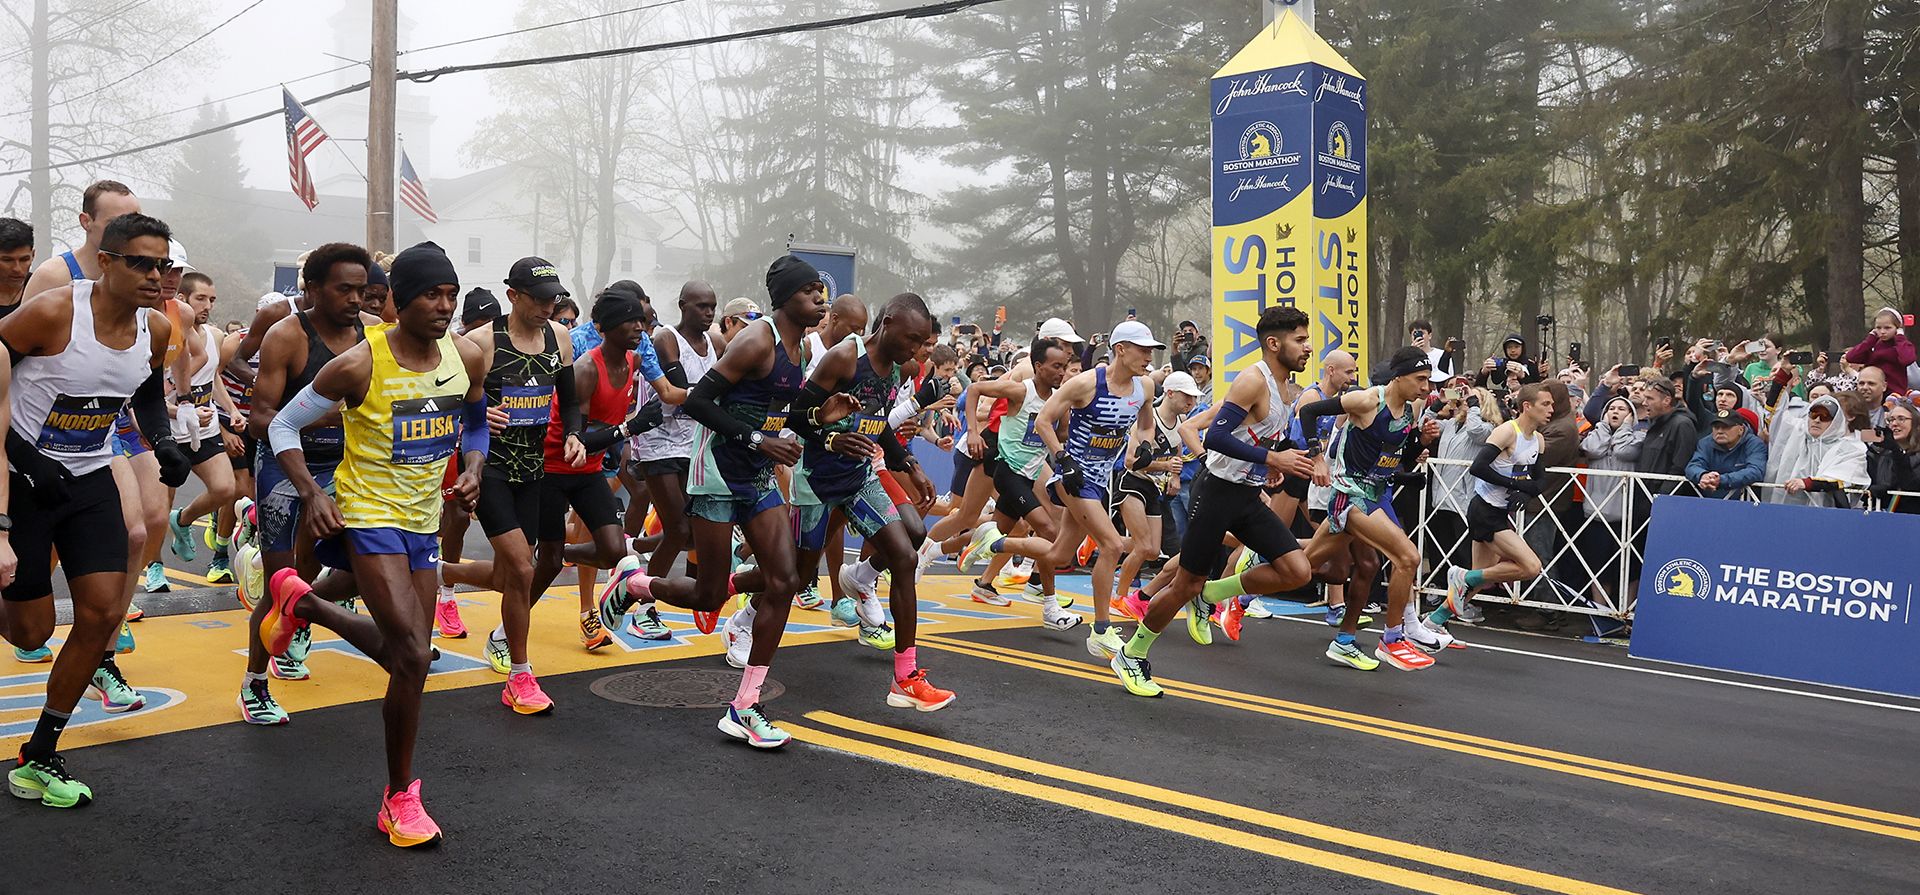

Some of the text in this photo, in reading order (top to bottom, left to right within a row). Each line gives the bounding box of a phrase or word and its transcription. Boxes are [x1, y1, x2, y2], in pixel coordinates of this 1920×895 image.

[1216, 79, 1253, 115] John
[1315, 71, 1336, 102] John
[1223, 161, 1254, 171] BOSTON
[1318, 155, 1336, 166] BOSTON
[1229, 178, 1255, 202] John
[1223, 234, 1267, 382] STA
[1318, 230, 1342, 378] STA
[401, 415, 454, 441] LELISA
[1666, 561, 1692, 571] ATHLETIC
[1692, 563, 1709, 597] ASSOCIATION
[1719, 564, 1893, 600] THE BOSTON
